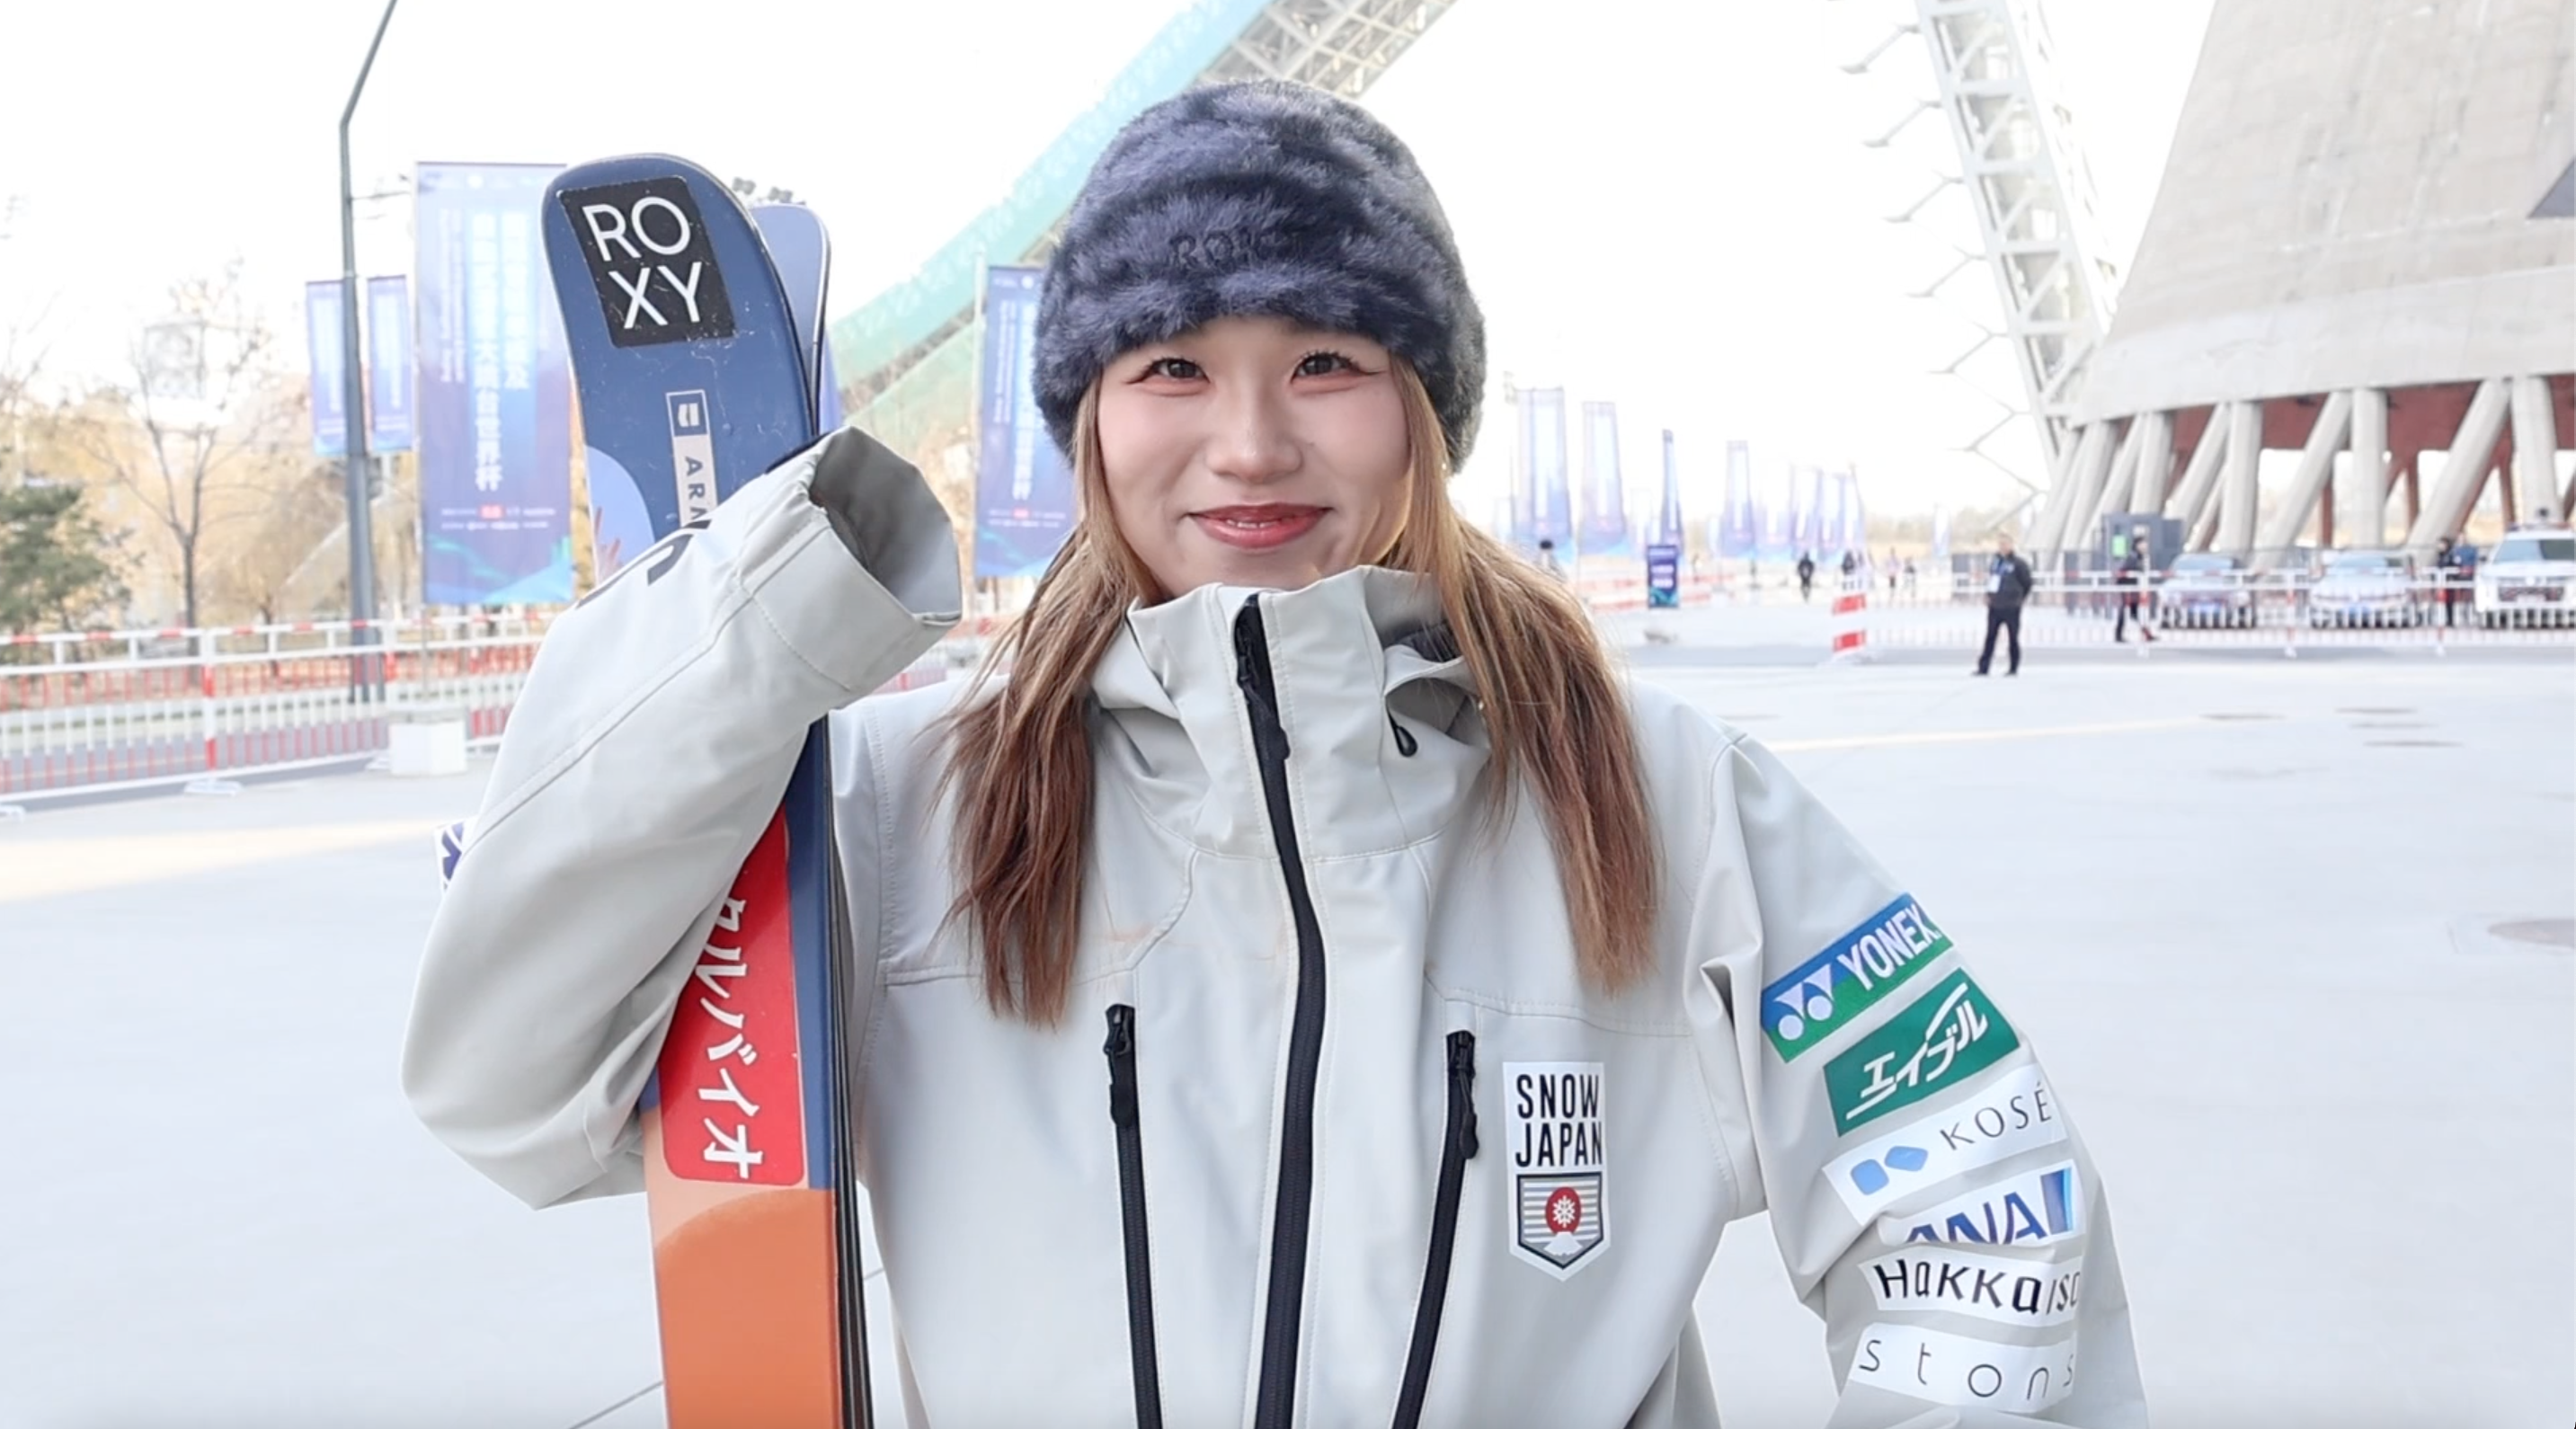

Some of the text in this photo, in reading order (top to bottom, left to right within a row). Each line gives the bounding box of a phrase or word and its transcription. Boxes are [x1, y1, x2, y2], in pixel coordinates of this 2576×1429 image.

[582, 196, 692, 262] RO
[608, 262, 703, 330] XY
[1836, 903, 1941, 991] YONEX
[1847, 982, 1989, 1120] エイブル
[1516, 1073, 1599, 1120] SNOW
[1939, 1080, 2053, 1151] KOSÉ
[1515, 1122, 1603, 1167] JAPAN
